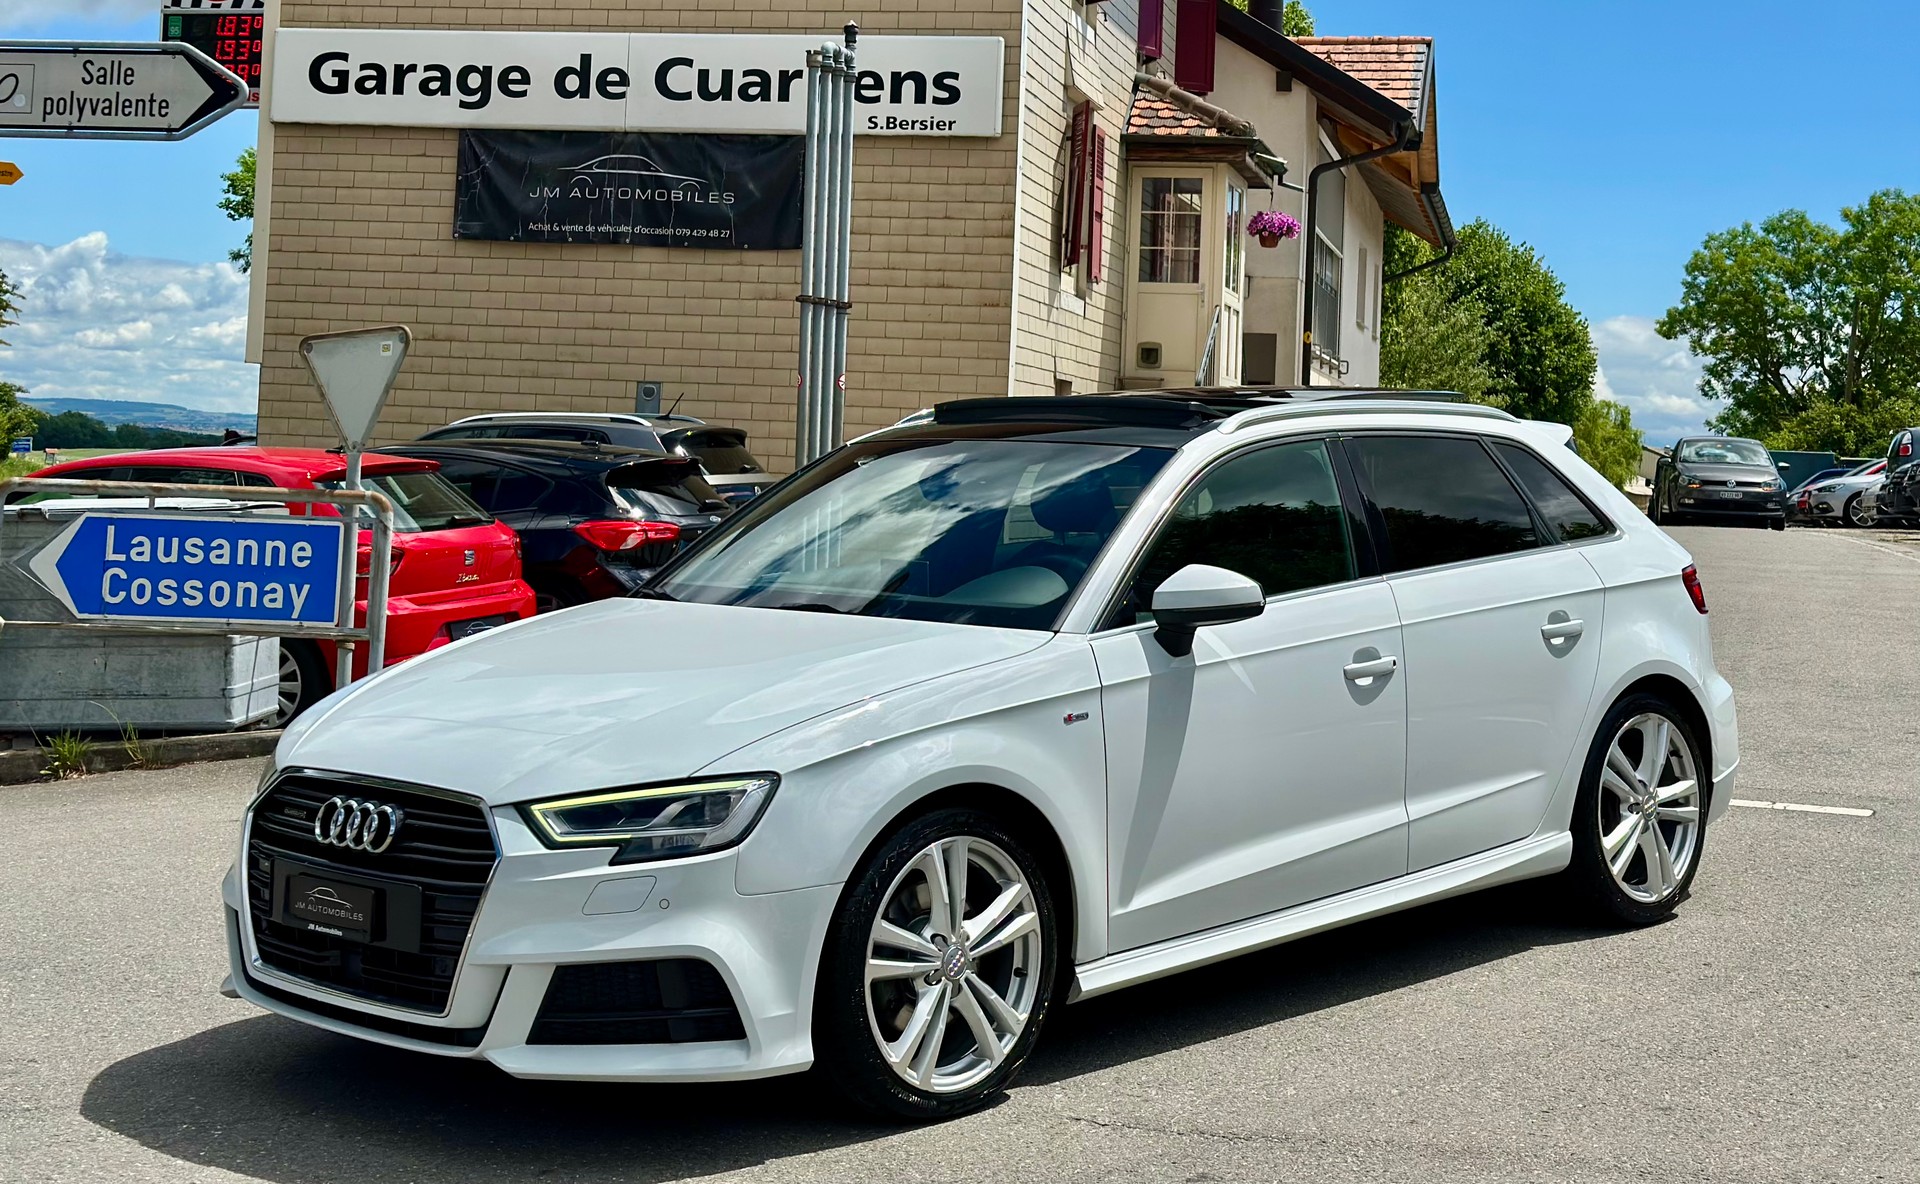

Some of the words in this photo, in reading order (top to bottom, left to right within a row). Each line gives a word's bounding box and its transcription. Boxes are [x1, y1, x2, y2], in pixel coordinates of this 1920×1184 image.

[81, 59, 135, 86] Salle
[308, 51, 532, 110] Garage
[553, 53, 631, 99] de
[654, 56, 962, 106] Cuarens
[42, 90, 170, 123] polyvalente
[867, 115, 957, 131] S.Bersier
[529, 187, 560, 198] JM
[569, 187, 735, 204] AUTOMOBILES
[528, 222, 551, 231] Achat
[553, 223, 560, 231] &
[561, 224, 584, 232] vente
[585, 224, 595, 232] de
[634, 225, 673, 235] d'occasion
[675, 228, 690, 236] 079
[692, 229, 707, 237] 429
[708, 229, 719, 237] 48
[720, 230, 730, 238] 27
[105, 525, 313, 568] Lausanne
[102, 567, 311, 619] Cossonay
[295, 901, 306, 909] JM
[307, 904, 364, 921] AUTOMOBILES
